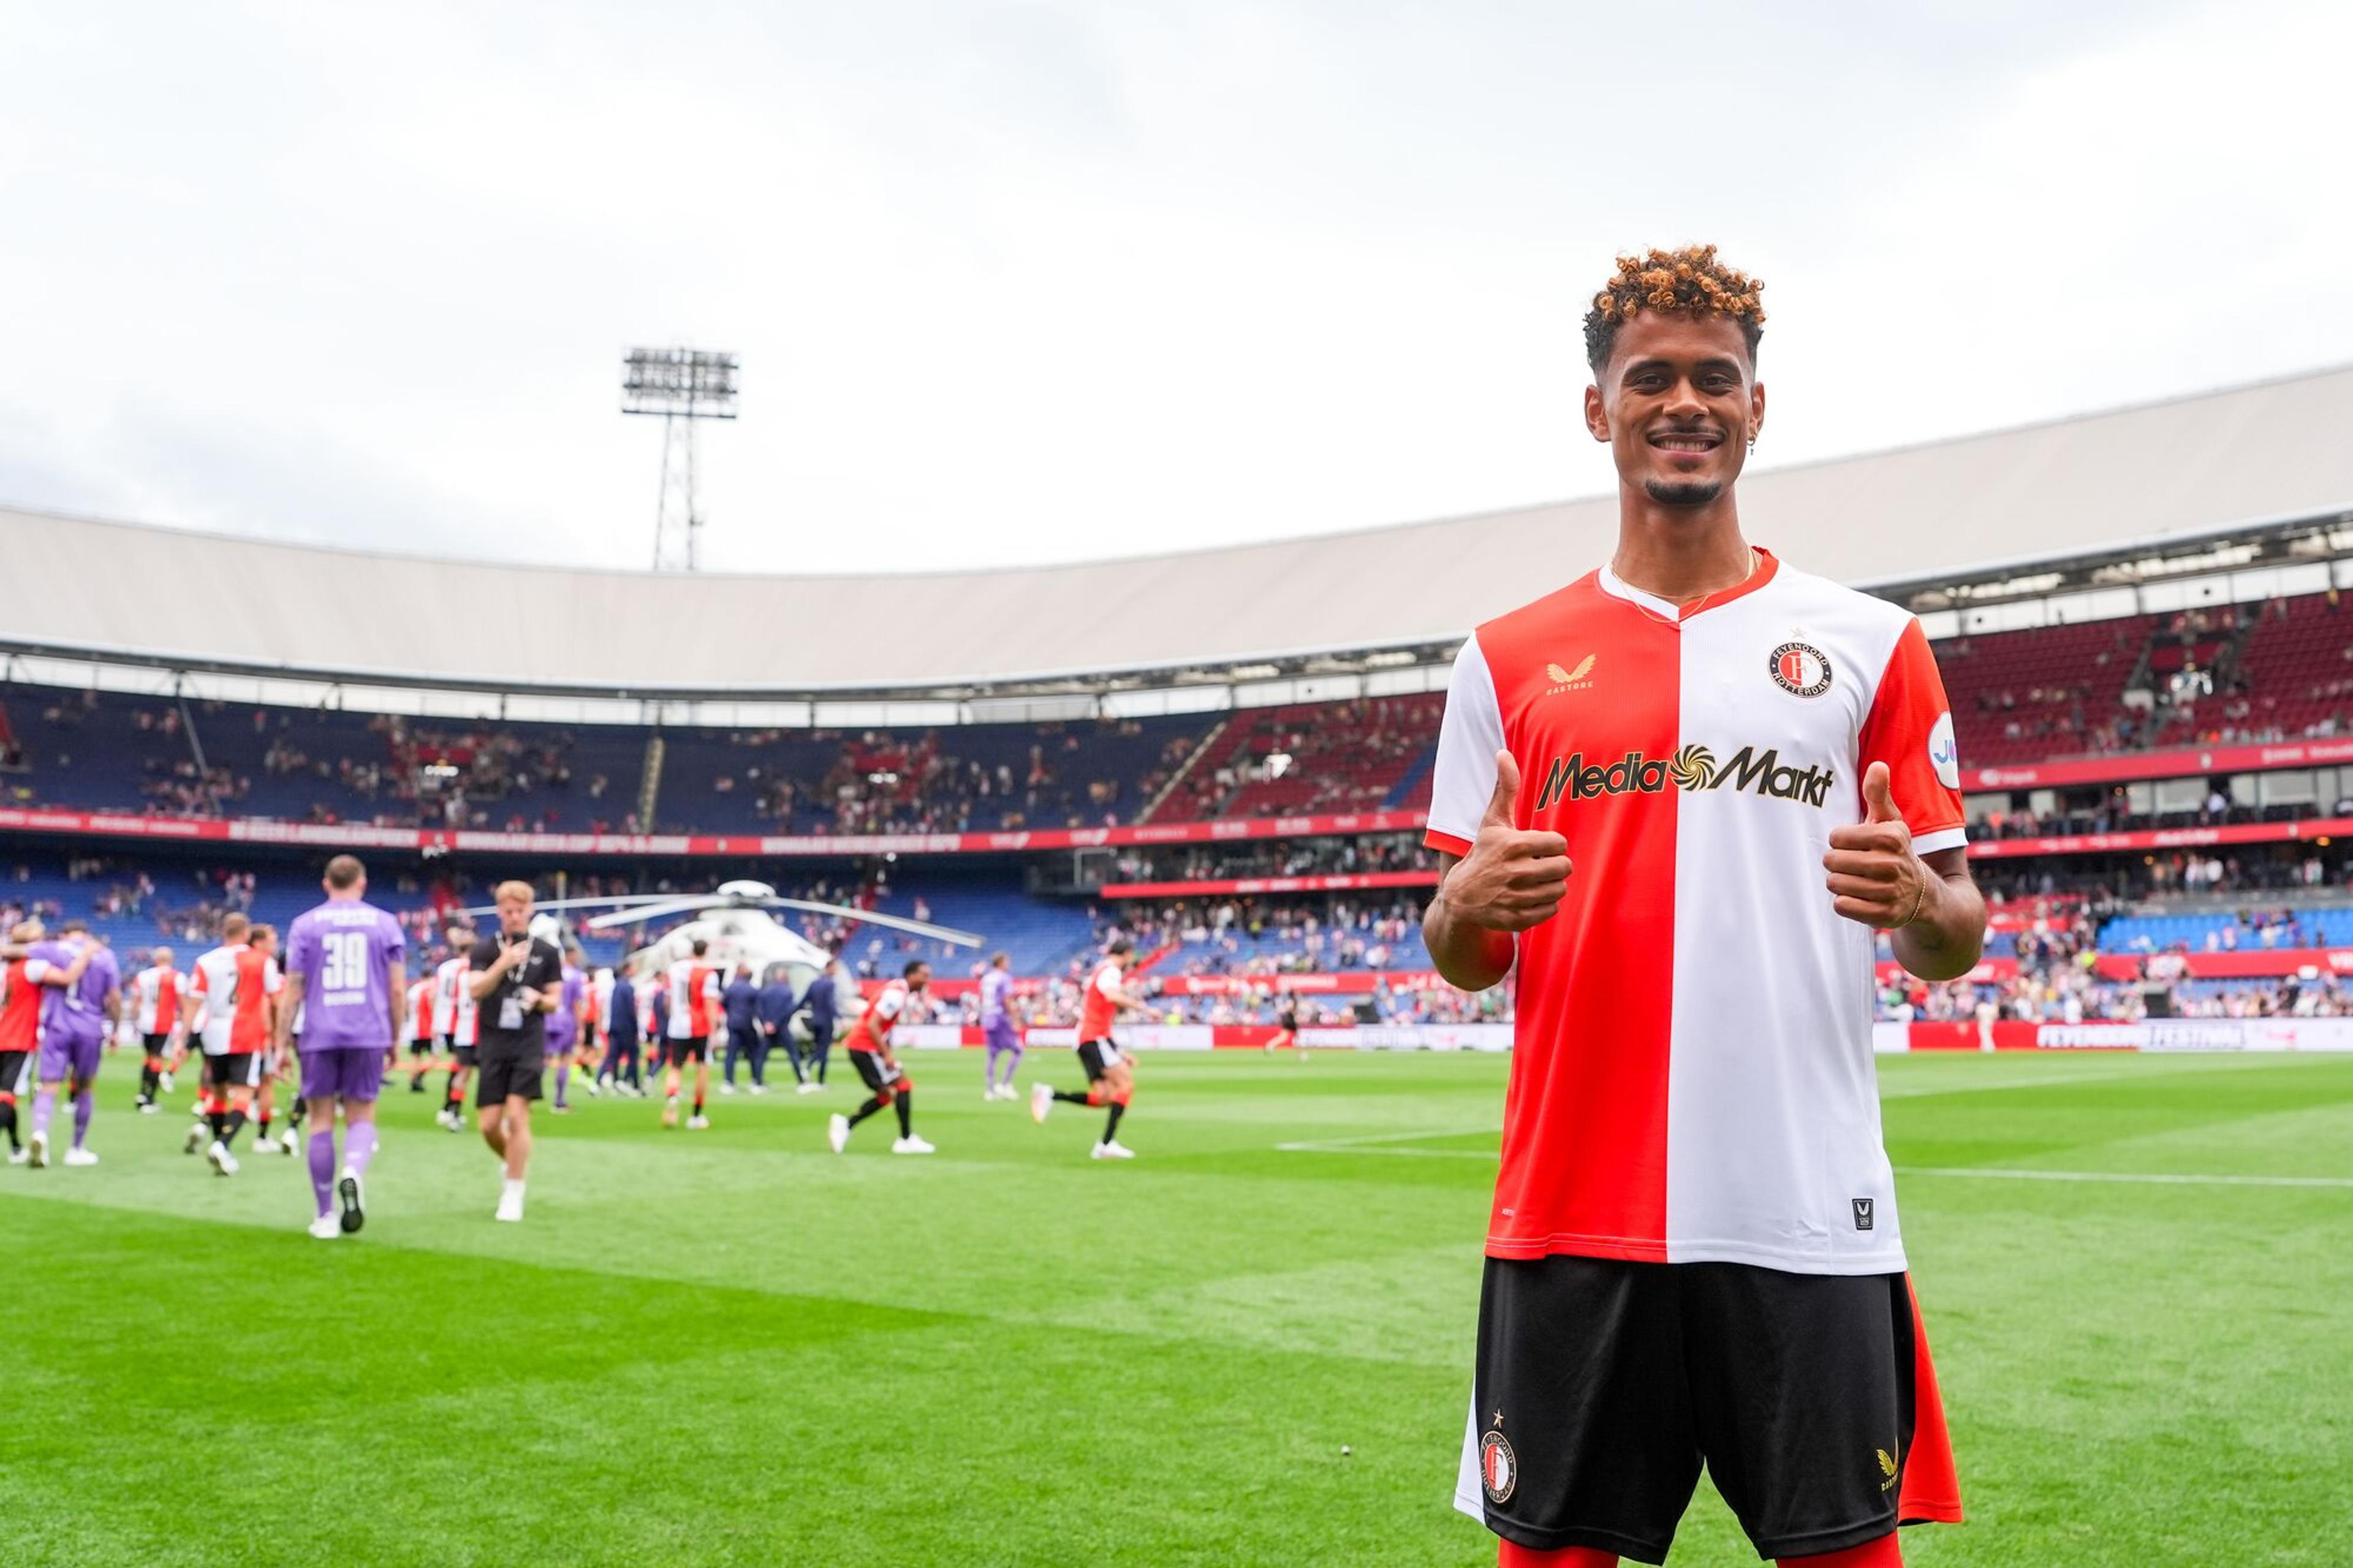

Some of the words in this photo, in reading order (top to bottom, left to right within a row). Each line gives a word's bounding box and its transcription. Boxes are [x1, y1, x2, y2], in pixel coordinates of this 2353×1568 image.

[1773, 643, 1828, 666] FEYENOORD
[1546, 681, 1594, 696] CASTORE
[1772, 672, 1831, 696] ROTTERDAM
[1534, 751, 1669, 812] Media
[1707, 746, 1835, 808] Markt
[322, 931, 366, 990] 39
